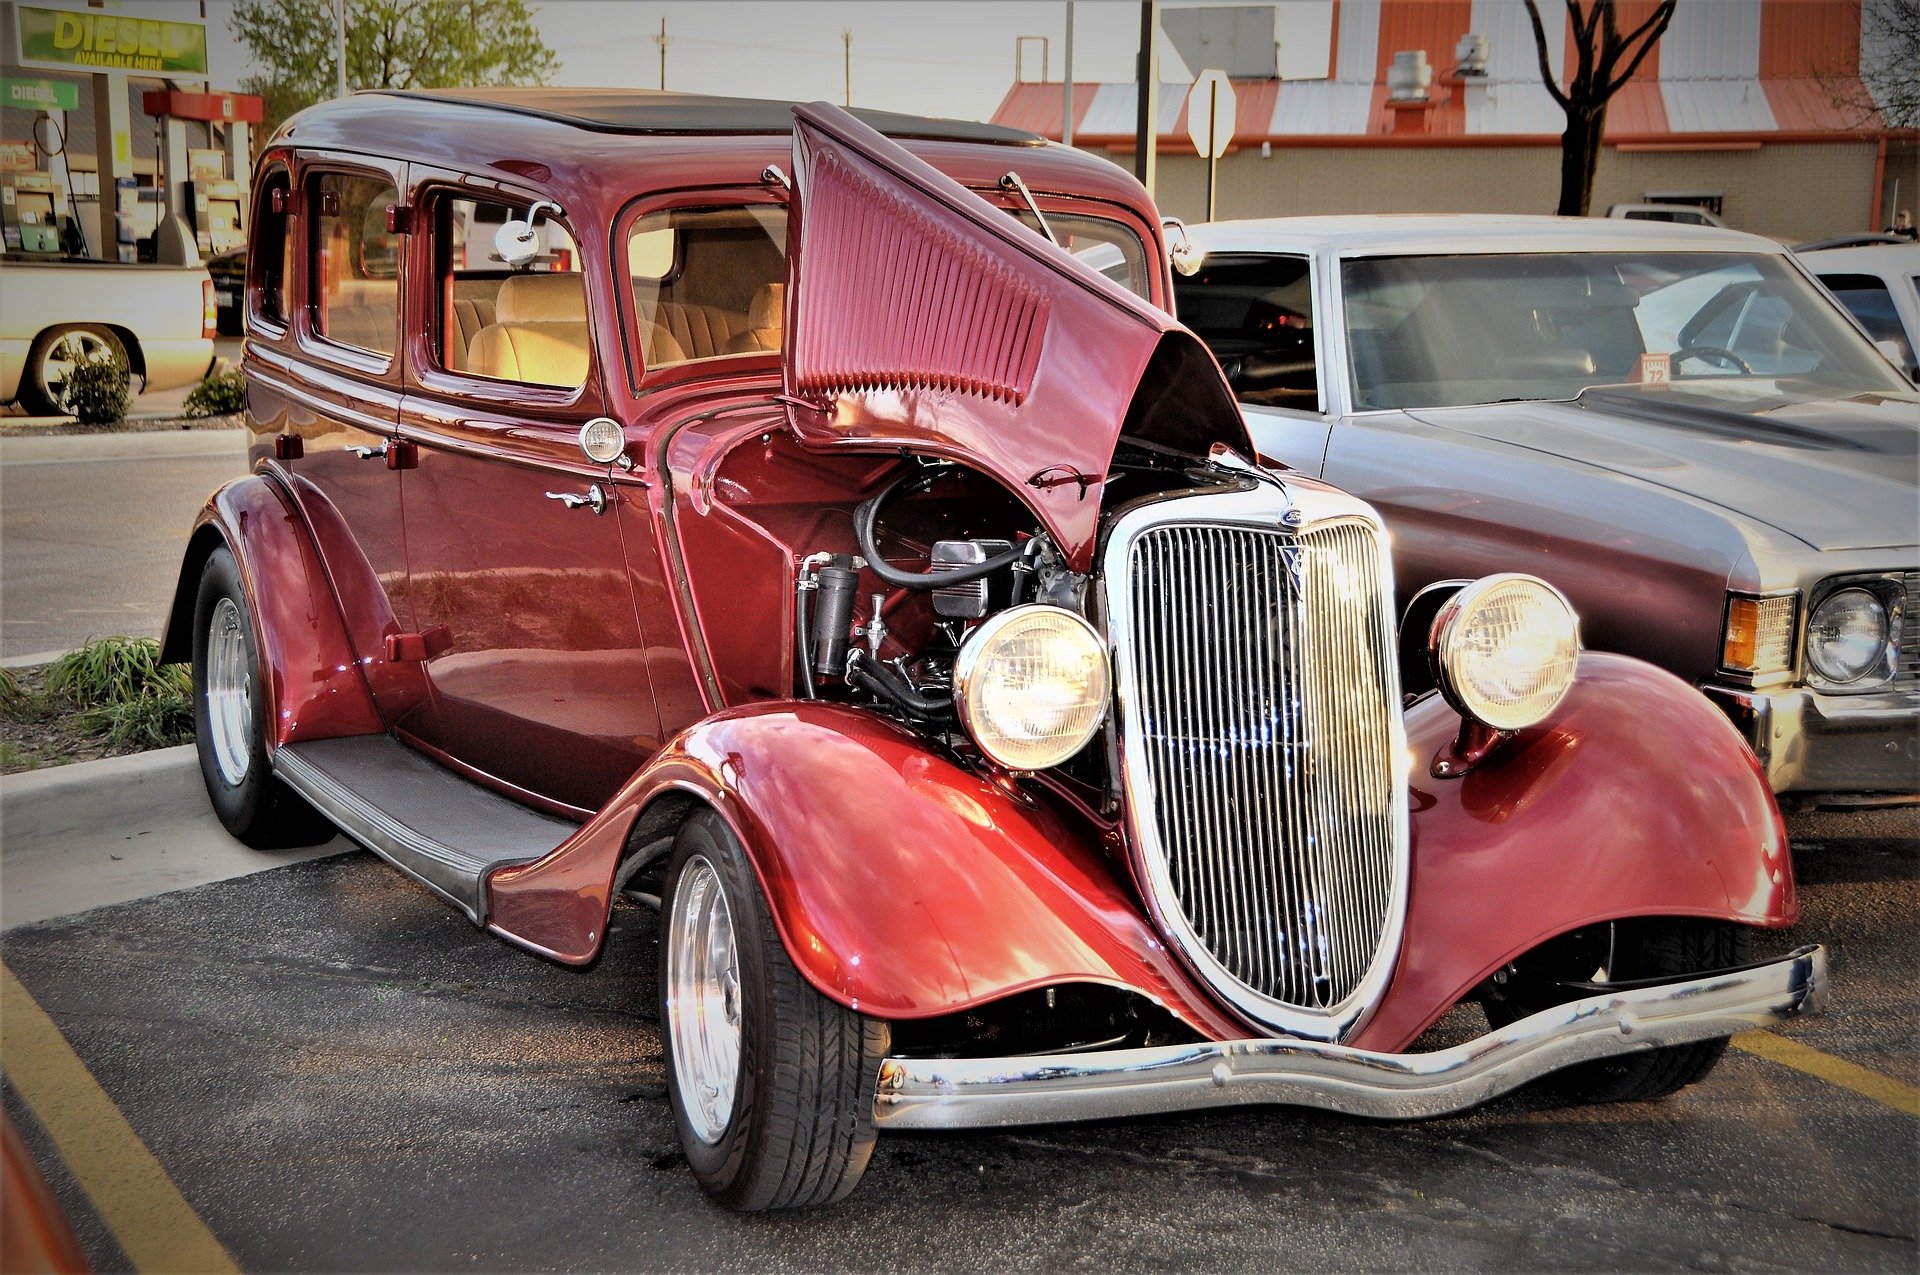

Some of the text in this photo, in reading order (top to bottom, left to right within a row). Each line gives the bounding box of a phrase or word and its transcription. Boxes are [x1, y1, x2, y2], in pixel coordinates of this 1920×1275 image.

[53, 11, 180, 59] DIESEL
[74, 51, 163, 71] AVAILABLE HERE
